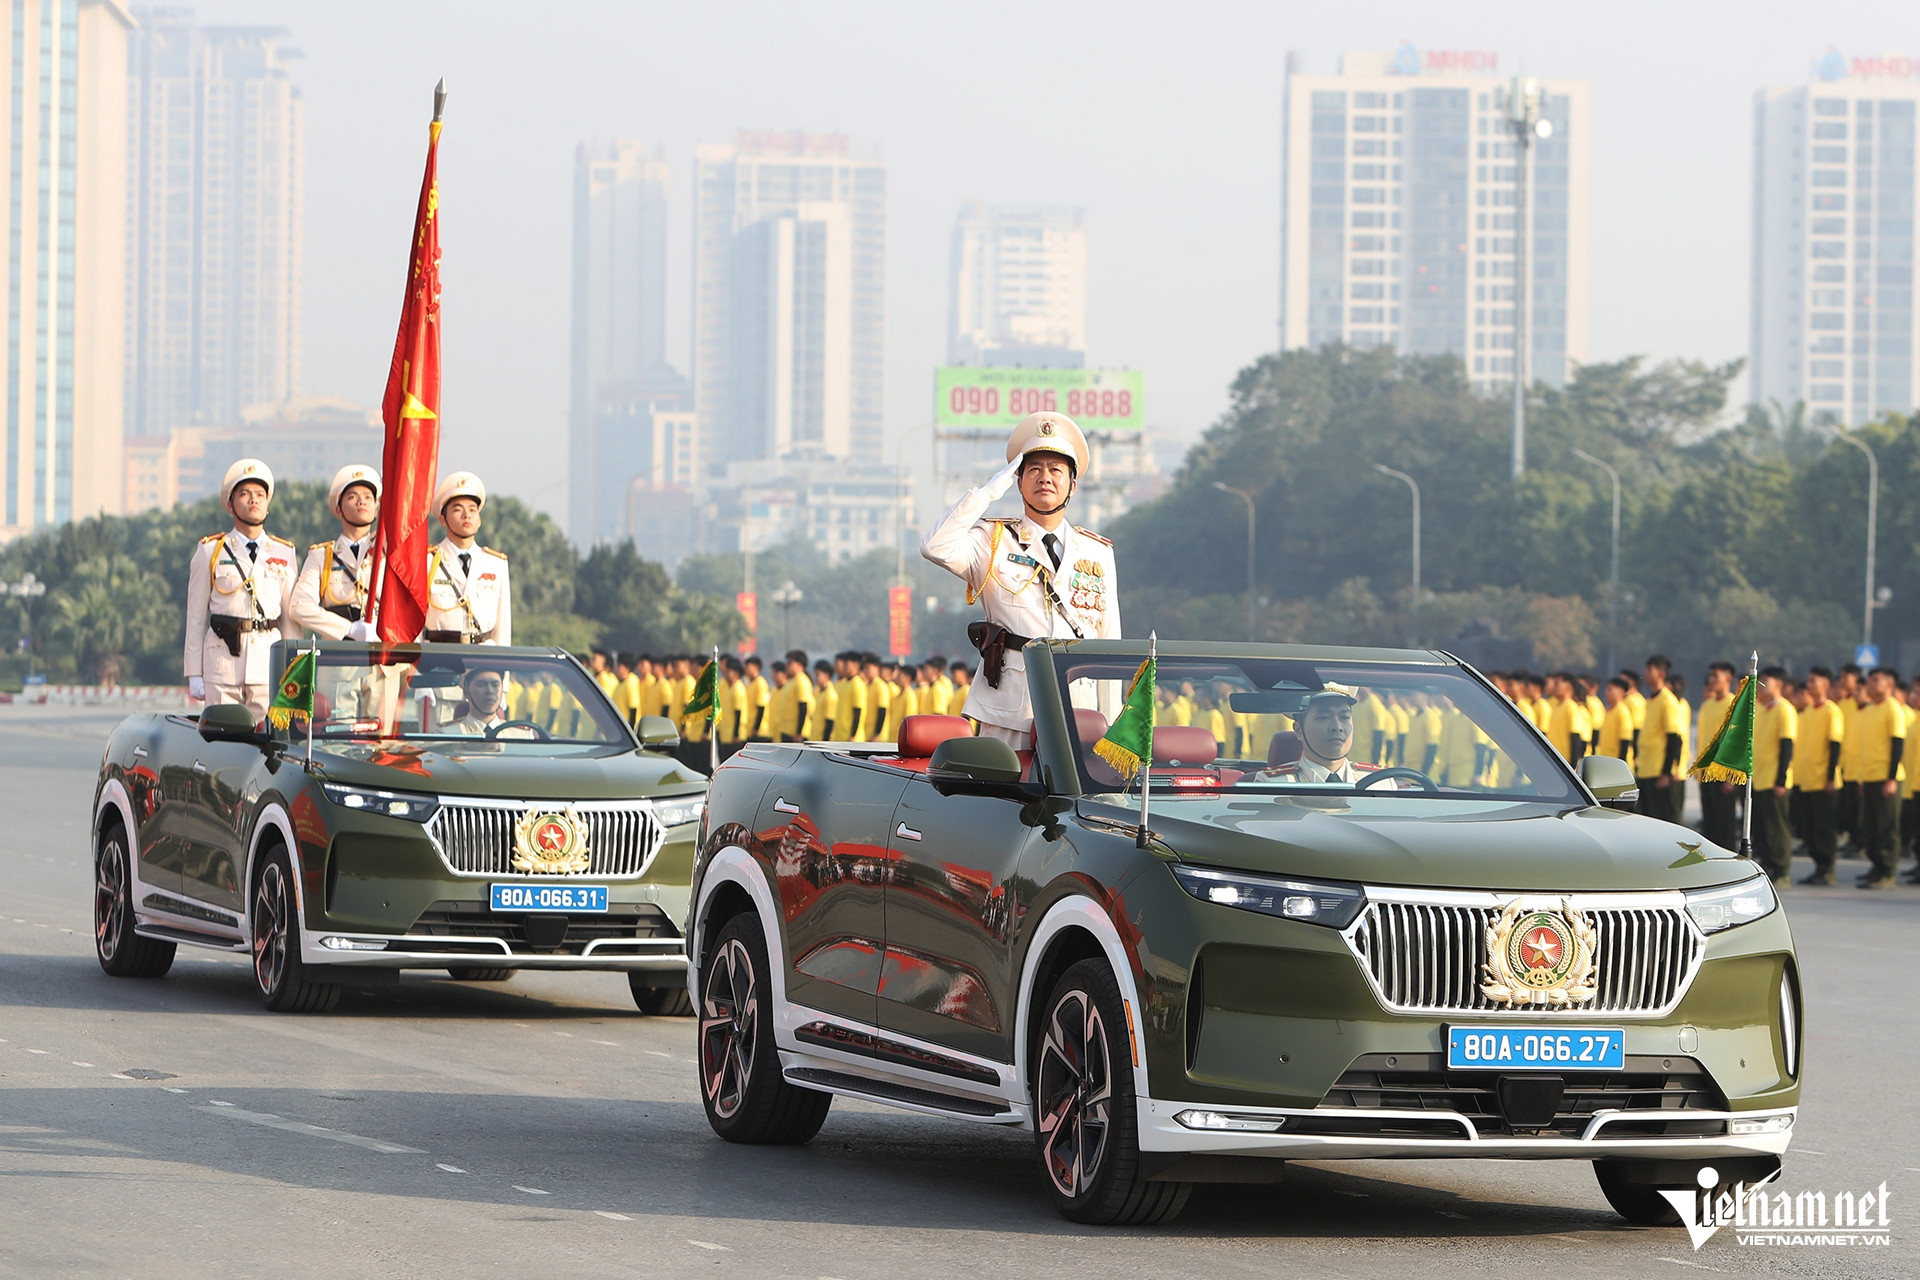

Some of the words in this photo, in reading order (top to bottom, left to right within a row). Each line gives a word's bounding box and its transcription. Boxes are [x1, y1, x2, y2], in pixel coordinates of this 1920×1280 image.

[951, 386, 998, 414] 090
[1009, 388, 1057, 415] 806
[1067, 389, 1132, 417] 8888
[501, 888, 597, 907] 80A-066.31
[1464, 1034, 1610, 1062] 80A-066.27
